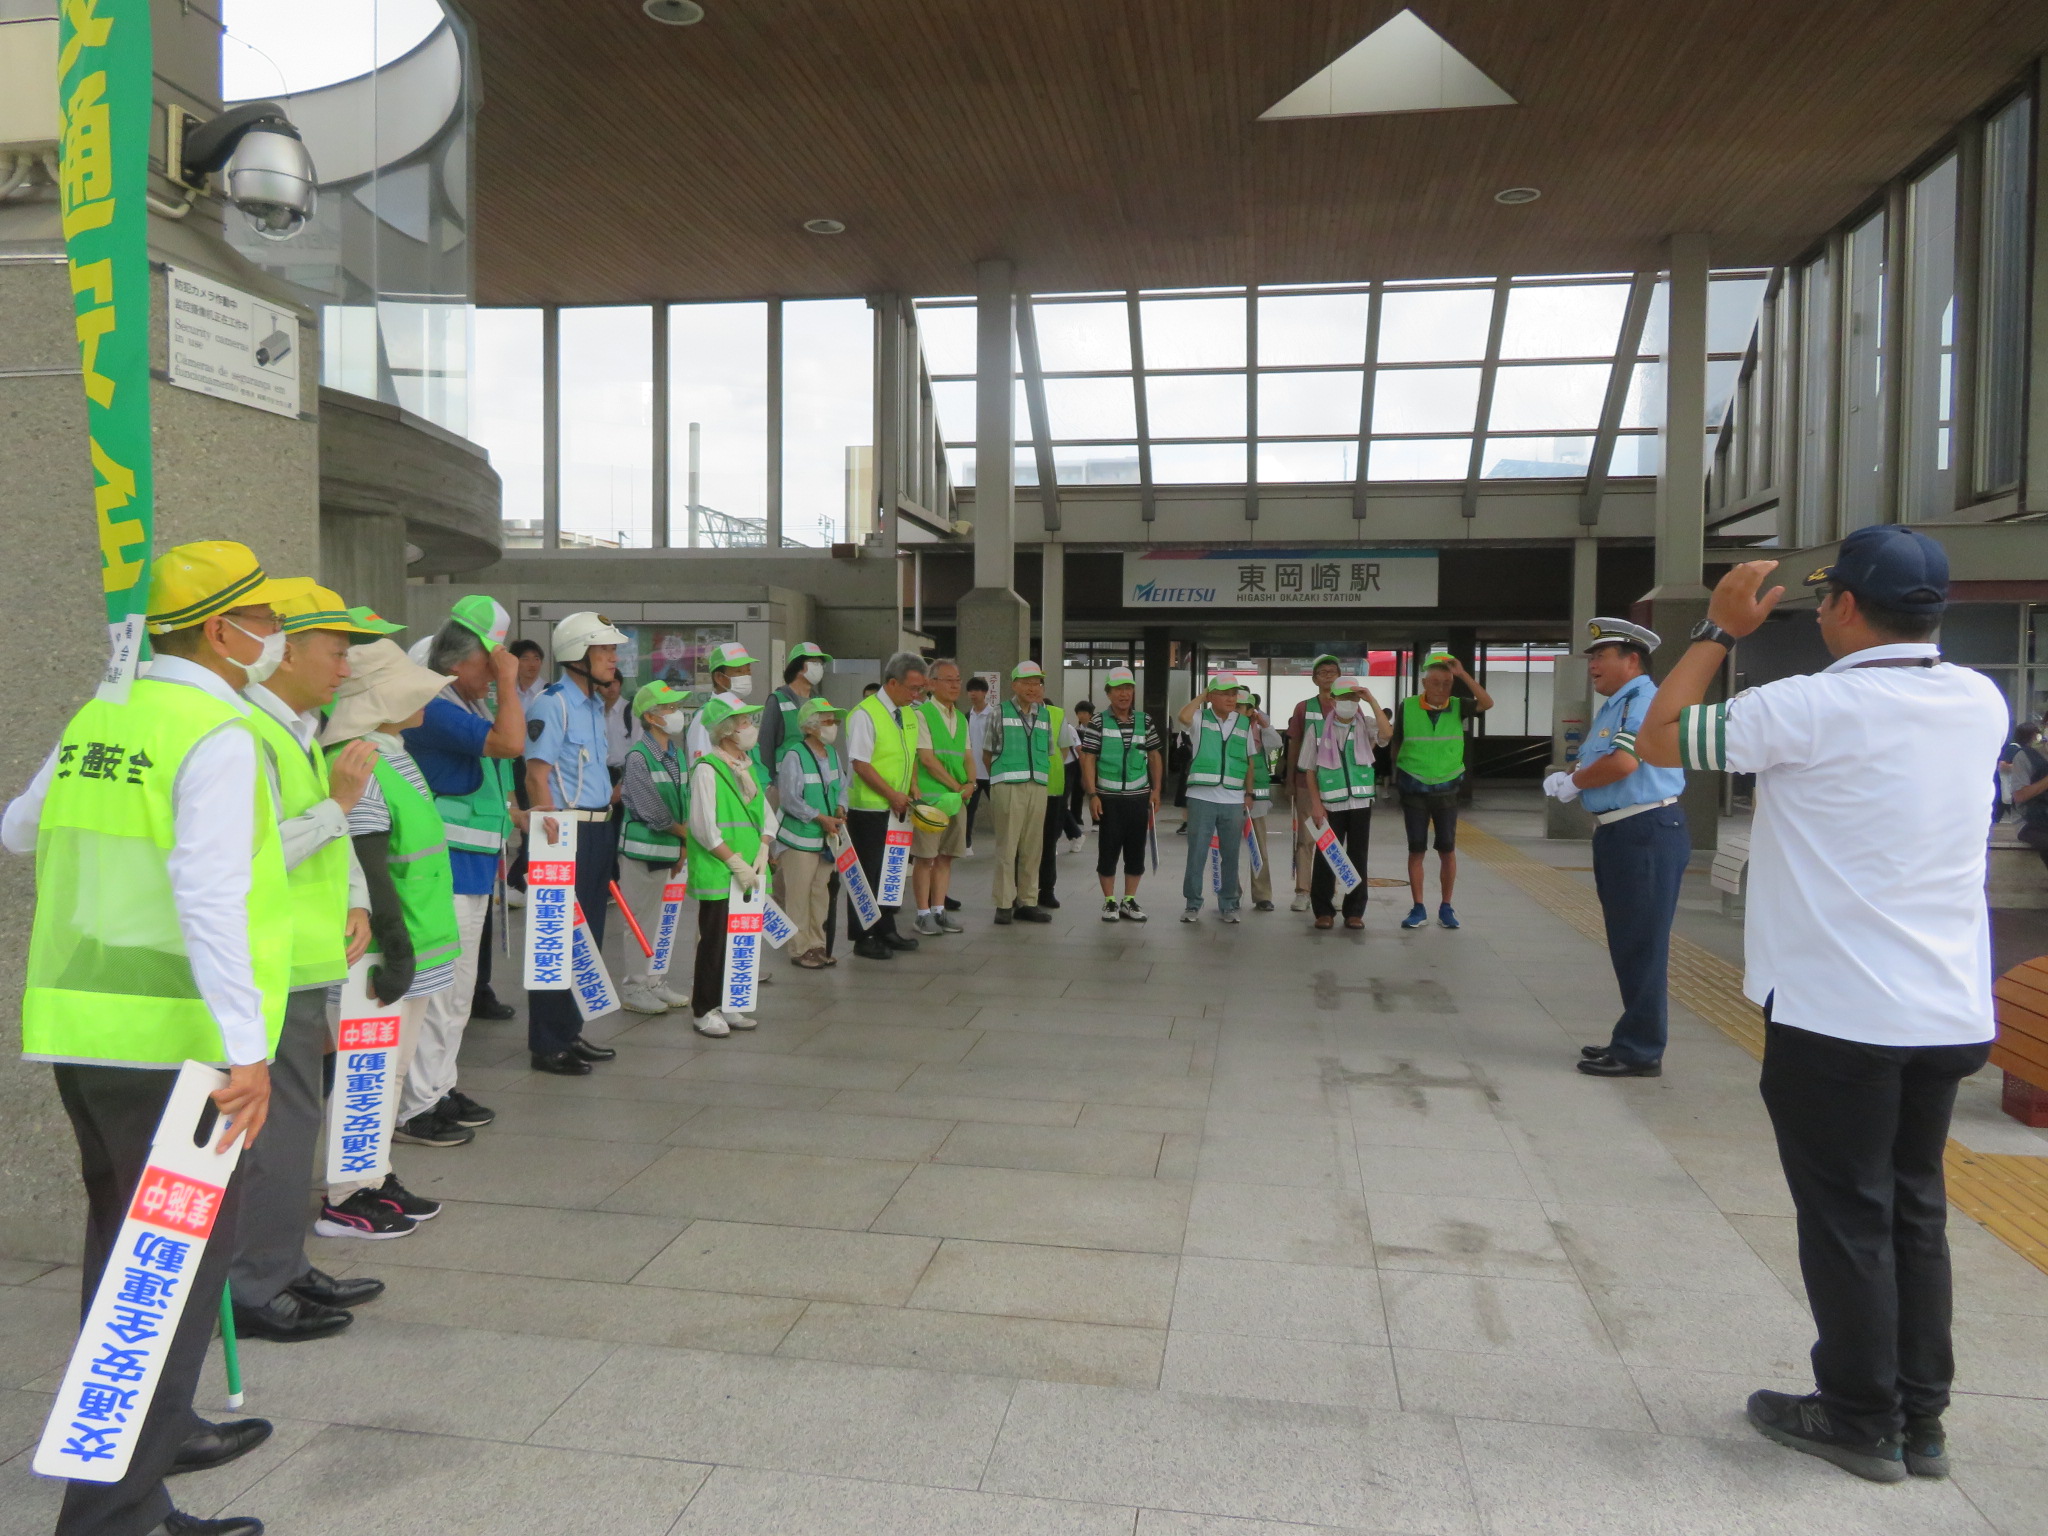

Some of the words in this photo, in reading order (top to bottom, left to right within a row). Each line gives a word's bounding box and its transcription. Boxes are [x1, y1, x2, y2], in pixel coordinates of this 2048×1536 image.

[174, 318, 211, 341] Security
[214, 333, 249, 351] cameras
[188, 338, 203, 349] use
[217, 365, 228, 377] de
[1132, 577, 1216, 602] MEITETSU
[1237, 563, 1381, 592] 東岡崎駅
[1237, 593, 1275, 602] HIGASHI
[1280, 593, 1320, 602] OKAZAKI
[1323, 593, 1361, 602] STATION
[532, 863, 572, 882] 実施中
[883, 847, 906, 902] 交通安全運動
[533, 888, 567, 984] 交通安全運動
[653, 903, 679, 971] 交通安全運動
[731, 916, 762, 930] 実施中
[763, 902, 791, 941] 交通安
[729, 935, 756, 1008] 交通安全運動
[344, 1019, 396, 1045] 実施中
[340, 1051, 388, 1173] 交通安全運動
[142, 1175, 219, 1228] 実施中
[60, 1231, 191, 1463] 交通安全運動
